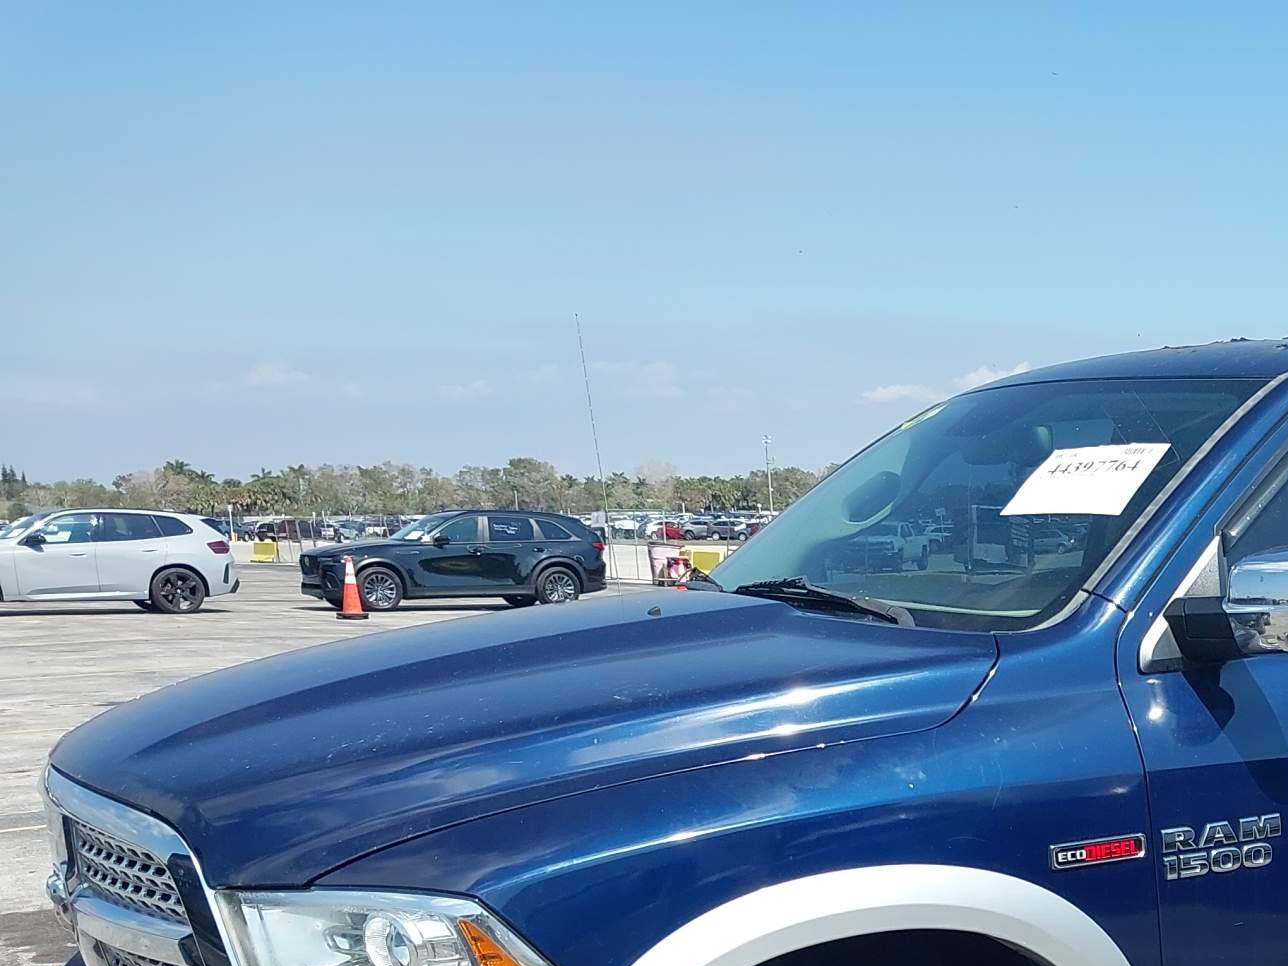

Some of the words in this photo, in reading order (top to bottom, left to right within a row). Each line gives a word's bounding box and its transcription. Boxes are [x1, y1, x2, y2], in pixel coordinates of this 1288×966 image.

[1047, 459, 1142, 475] 44397764
[1160, 812, 1282, 853] RAM
[1163, 842, 1273, 881] 1500
